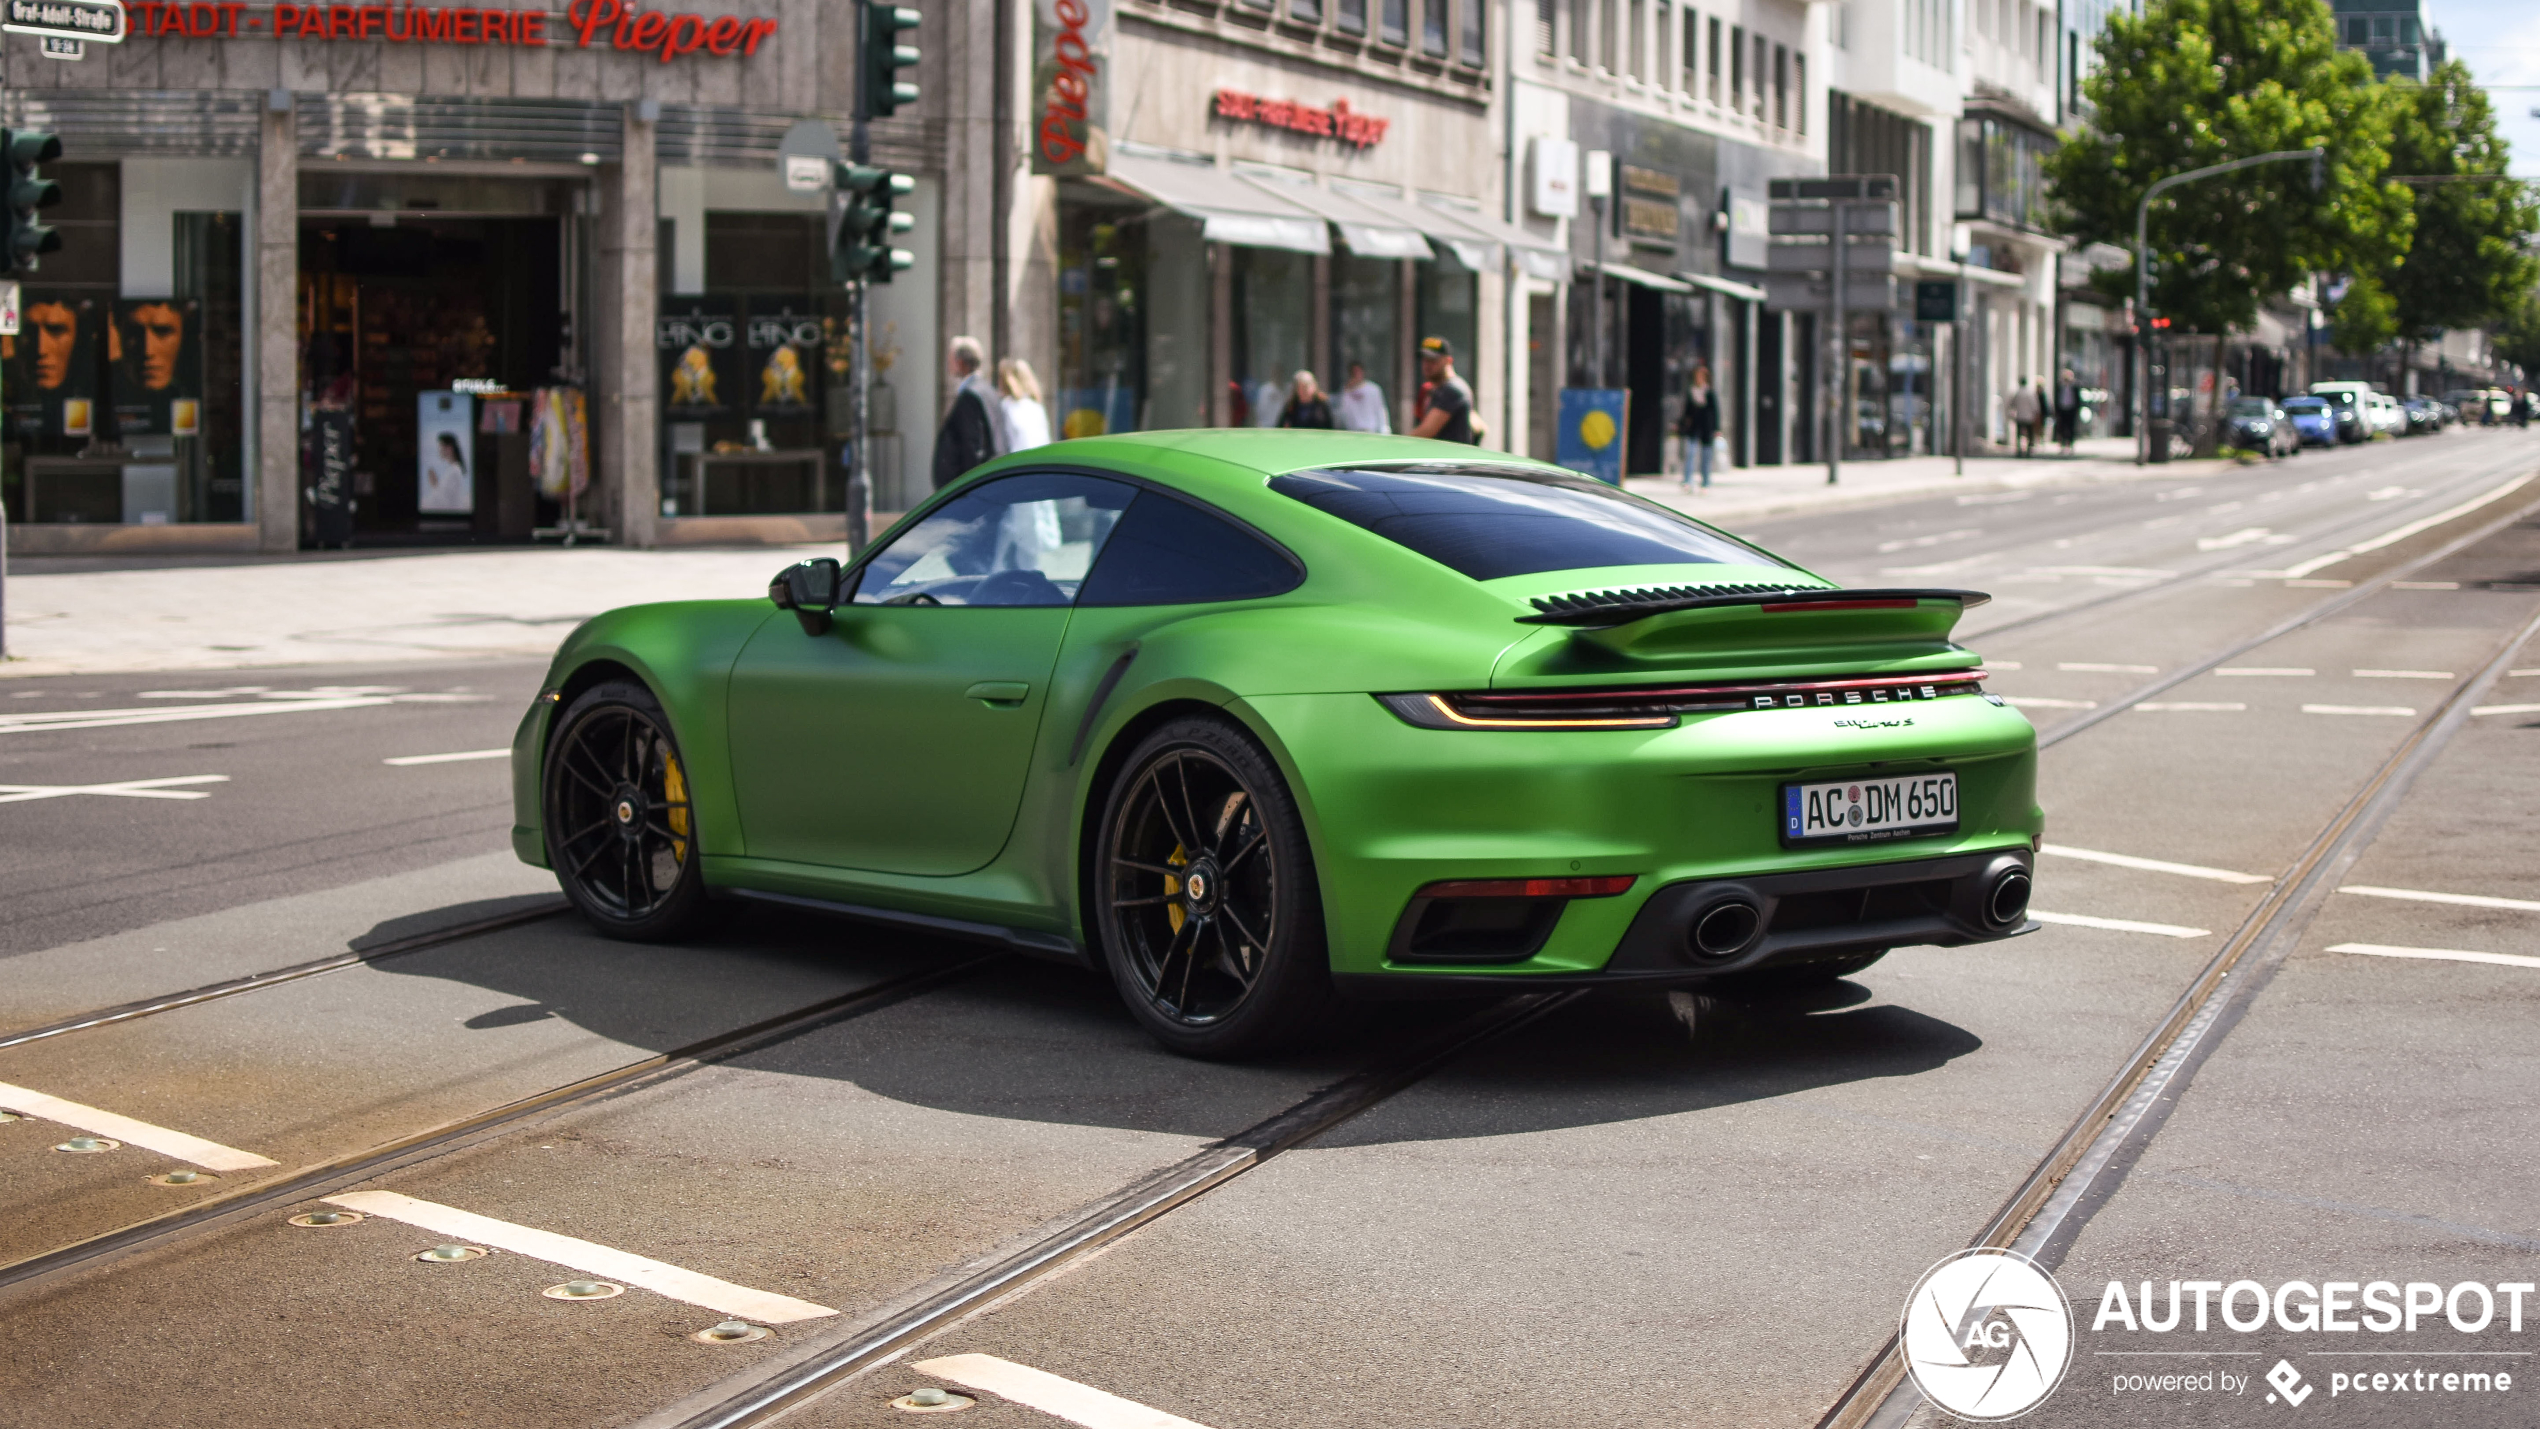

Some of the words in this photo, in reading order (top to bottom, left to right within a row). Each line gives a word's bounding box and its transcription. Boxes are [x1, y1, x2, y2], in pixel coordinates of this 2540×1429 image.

[568, 0, 778, 63] Pieper
[1754, 685, 1937, 709] PORSCHE
[1790, 817, 1799, 829] D
[1807, 788, 1845, 830] AC
[1865, 783, 1902, 824] DM
[1907, 778, 1955, 820] 650
